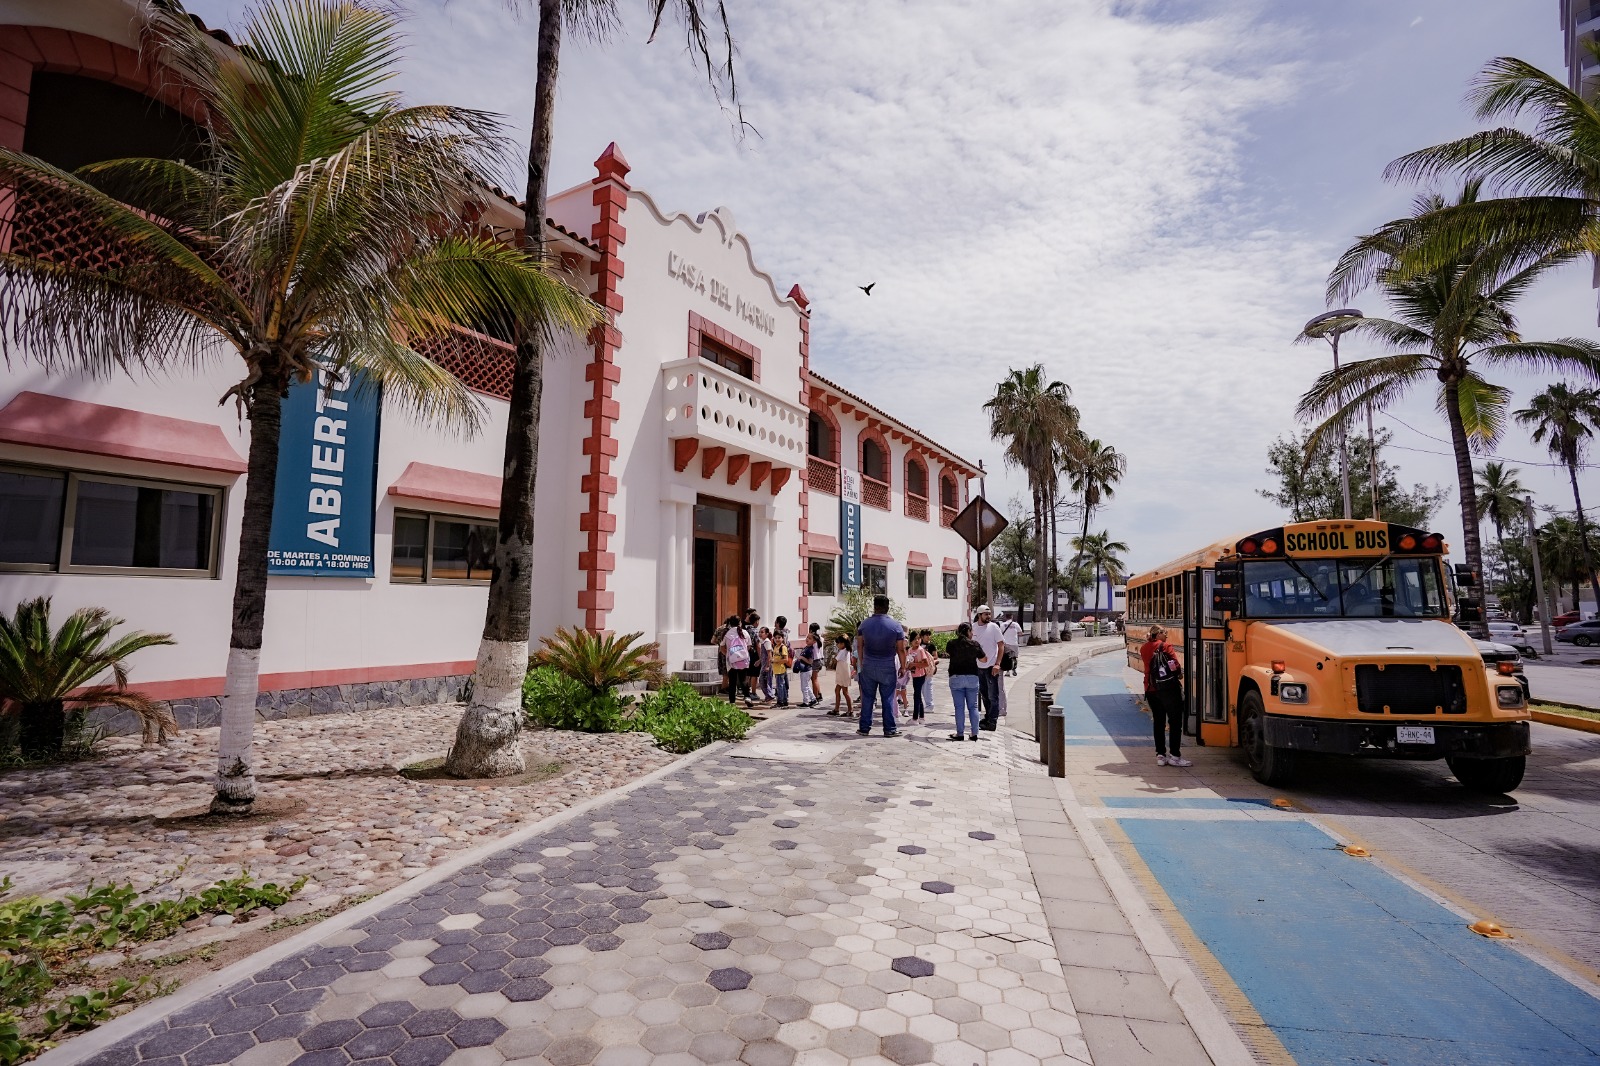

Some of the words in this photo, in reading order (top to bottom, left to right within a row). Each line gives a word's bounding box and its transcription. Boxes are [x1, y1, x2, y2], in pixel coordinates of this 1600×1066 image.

[668, 250, 707, 296] CASA
[710, 278, 732, 312] DEL
[736, 294, 776, 338] MARINO
[847, 504, 855, 582] ABIERTO
[1286, 531, 1349, 551] SCHOOL
[1355, 530, 1387, 549] BUS
[267, 550, 280, 558] DE
[283, 551, 320, 560] MARTES
[332, 554, 371, 562] DOMINGO
[270, 558, 296, 566] 10:00
[299, 559, 314, 567] AM
